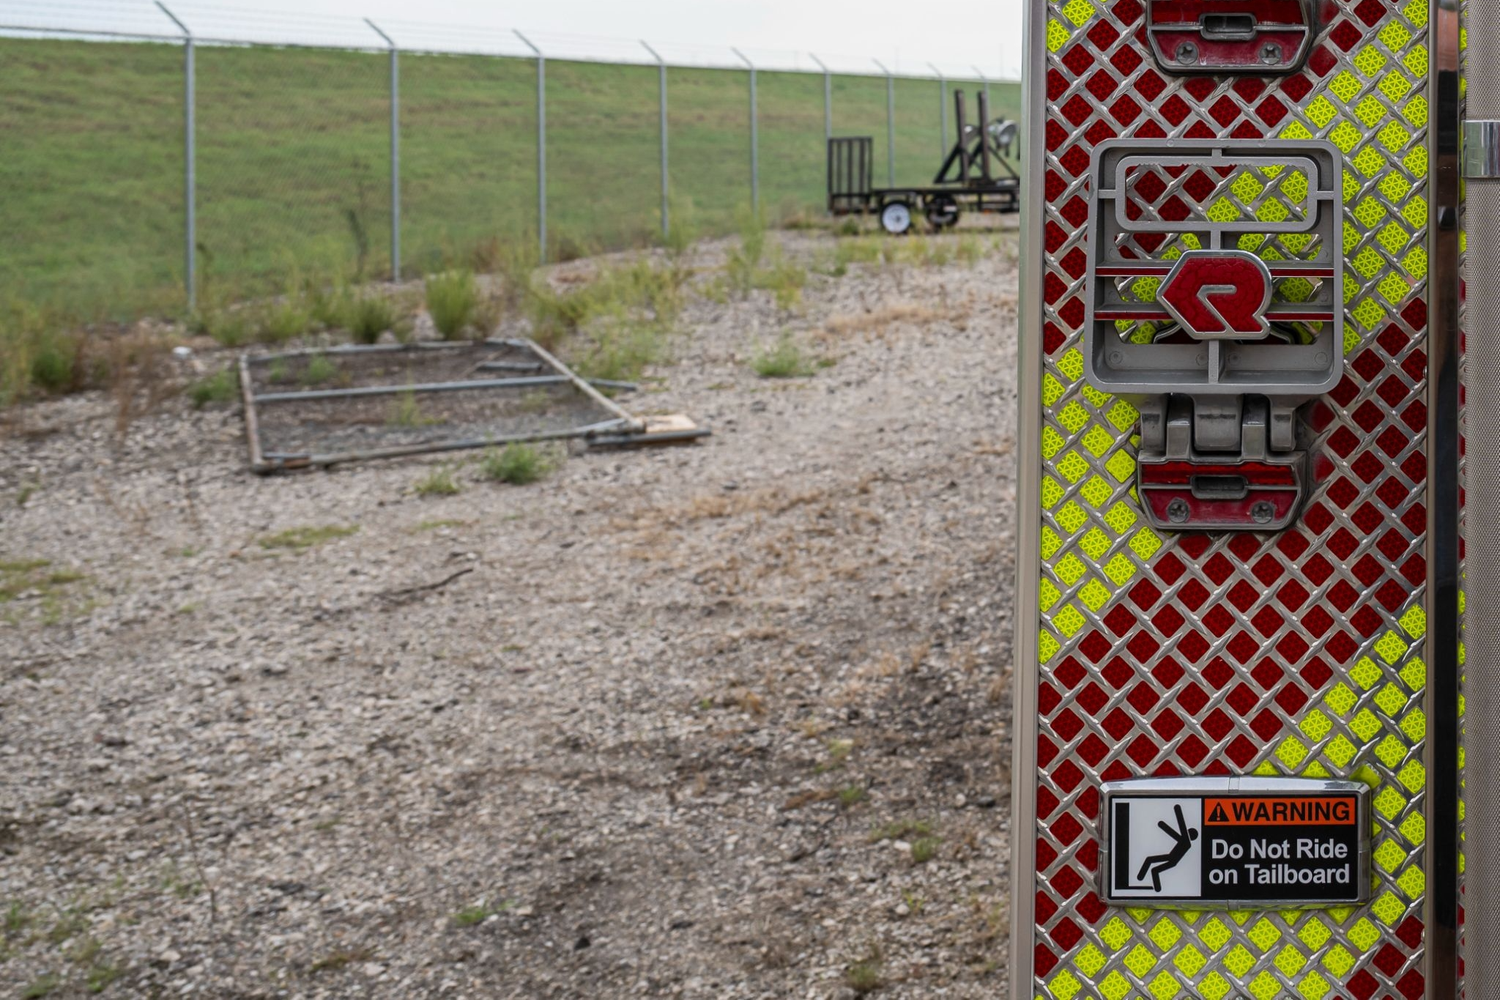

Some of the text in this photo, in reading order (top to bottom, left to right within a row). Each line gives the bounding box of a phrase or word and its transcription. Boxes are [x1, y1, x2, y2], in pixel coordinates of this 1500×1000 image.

[1231, 801, 1350, 822] WARNING
[1211, 838, 1348, 859] Do Not Ride
[1208, 863, 1350, 884] on Tailboard
